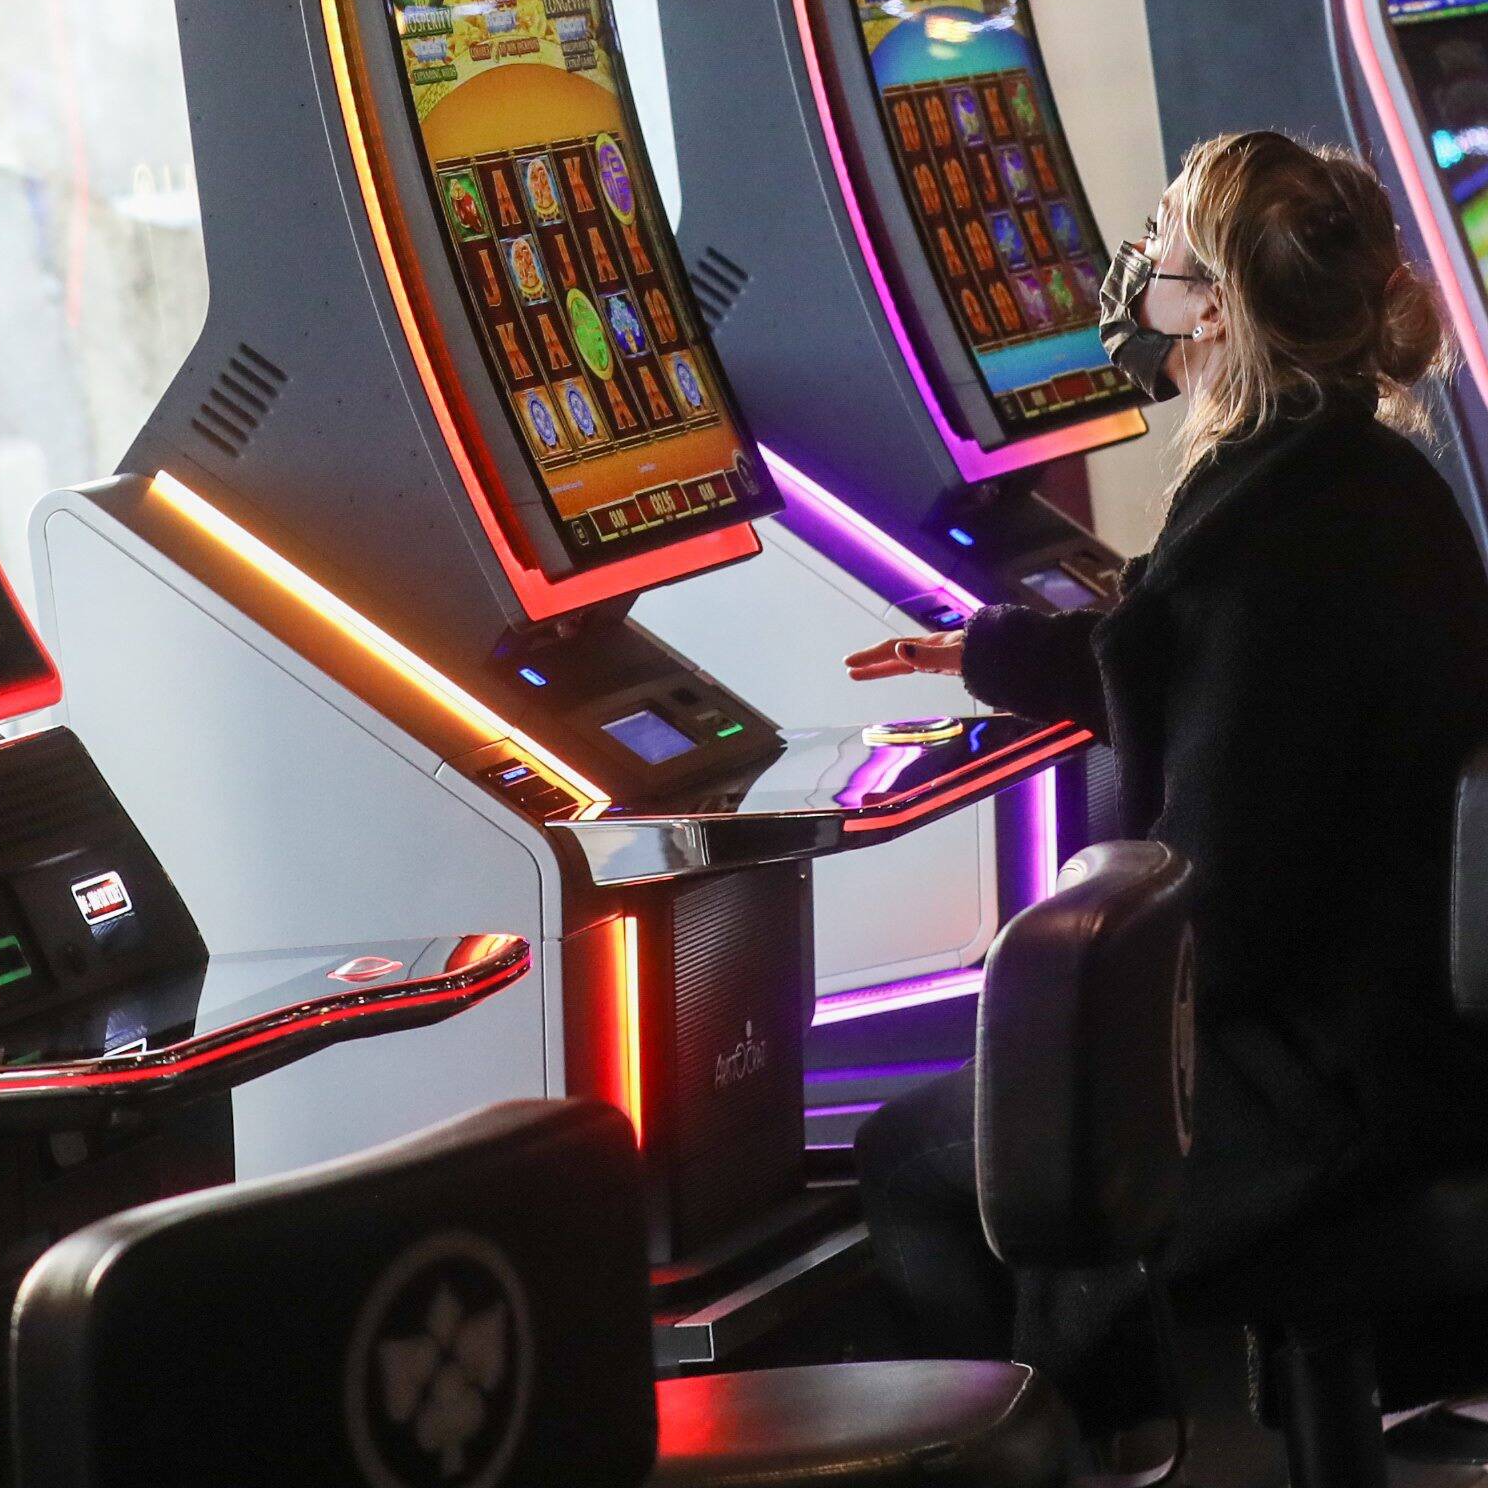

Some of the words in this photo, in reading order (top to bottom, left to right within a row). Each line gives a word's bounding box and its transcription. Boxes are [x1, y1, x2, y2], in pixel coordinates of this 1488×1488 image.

[492, 170, 521, 226] A
[563, 157, 595, 212] K
[555, 234, 577, 289] J
[588, 227, 618, 282] A
[623, 220, 653, 275] K
[479, 249, 501, 307] J
[496, 322, 533, 379] K
[538, 314, 572, 370] A
[638, 366, 673, 420] A
